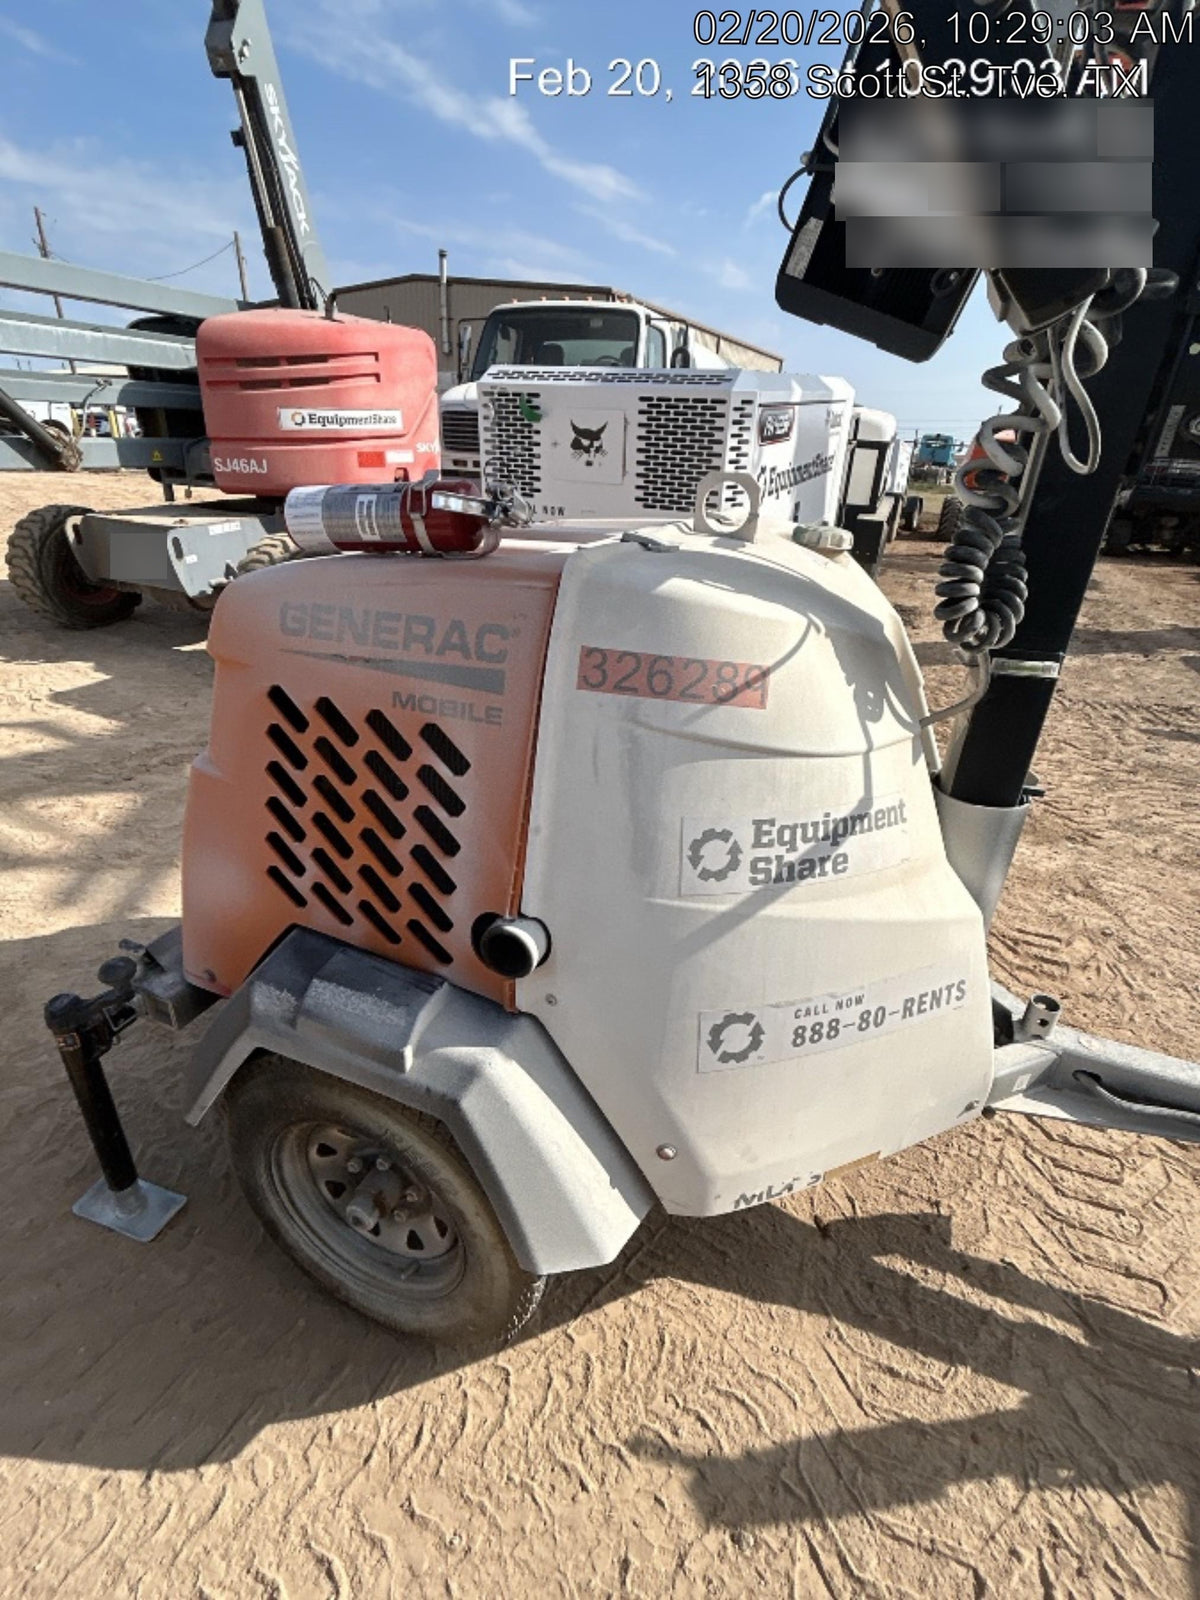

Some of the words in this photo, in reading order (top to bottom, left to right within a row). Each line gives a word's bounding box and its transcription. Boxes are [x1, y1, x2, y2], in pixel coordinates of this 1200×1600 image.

[214, 458, 268, 474] SJ46AJ
[279, 601, 508, 663] GENERAC
[584, 647, 766, 704] 326289
[392, 691, 503, 725] MOBILE
[752, 798, 908, 853] Equipment
[749, 852, 850, 885] Share
[791, 979, 967, 1048] 888-80-RENTS
[794, 1003, 829, 1019] CALL
[835, 994, 865, 1011] NOW
